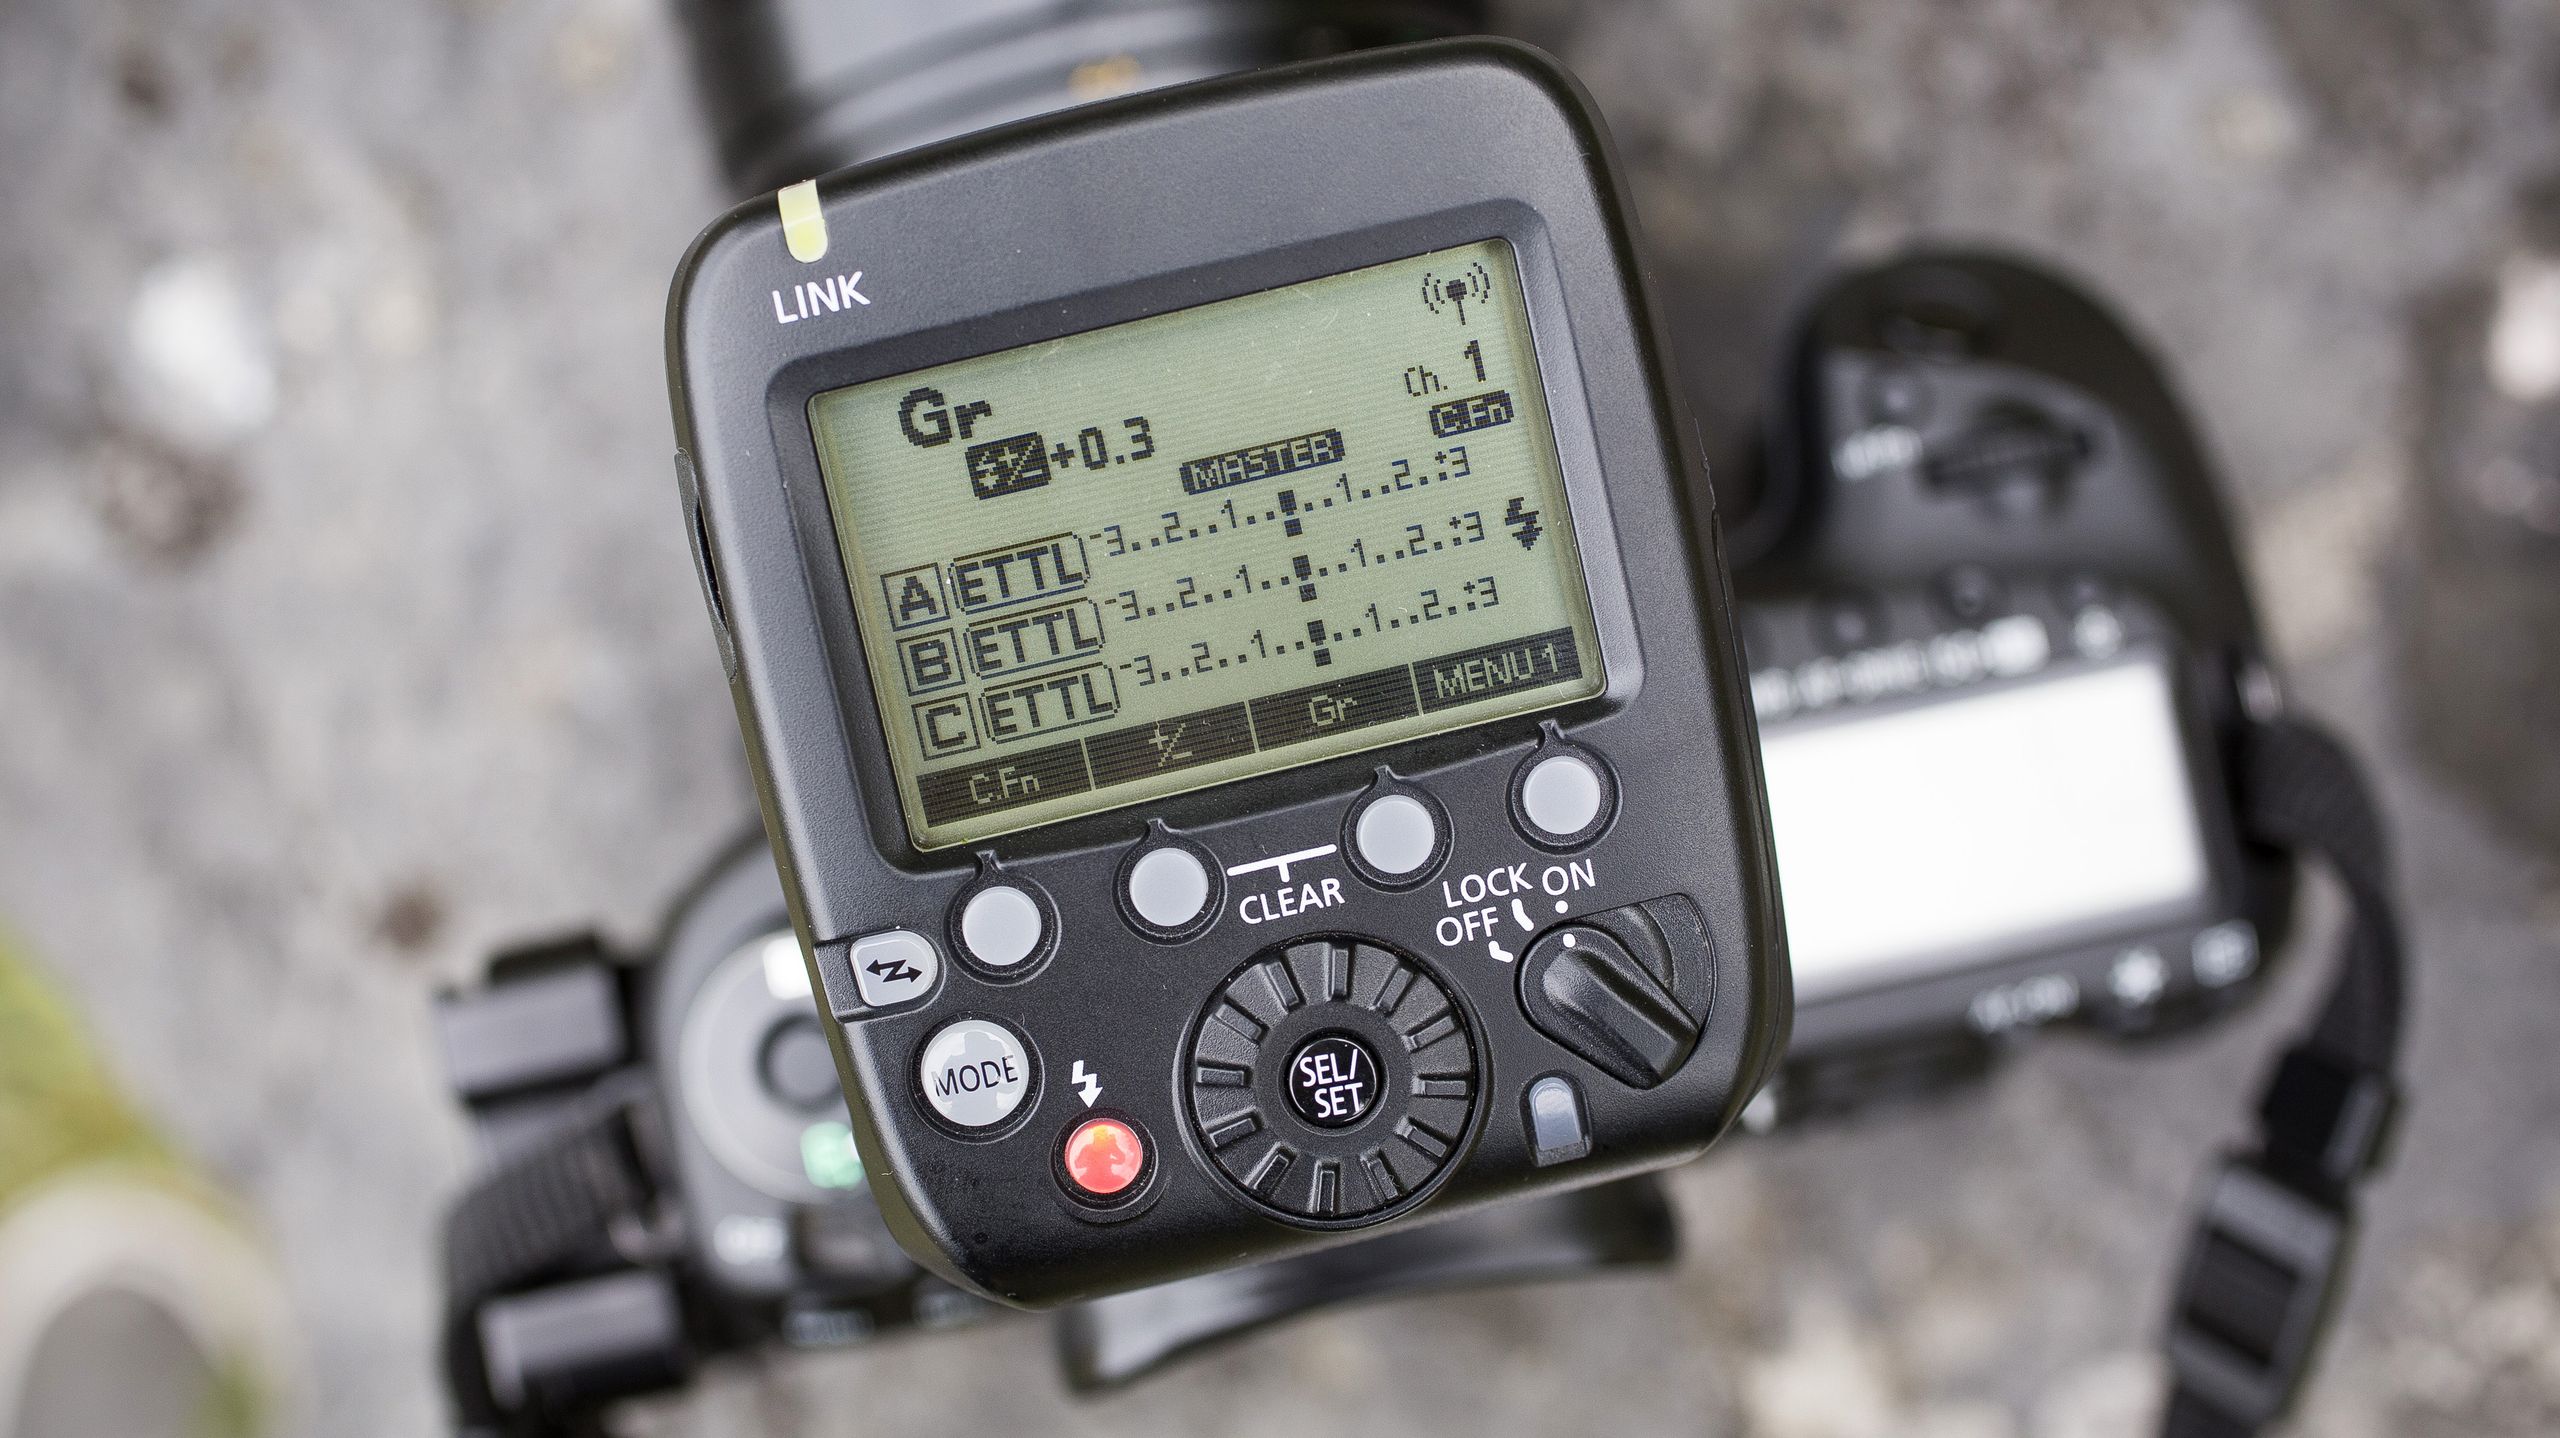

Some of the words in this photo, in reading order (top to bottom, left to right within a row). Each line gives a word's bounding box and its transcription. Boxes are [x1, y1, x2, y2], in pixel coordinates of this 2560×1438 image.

[771, 270, 871, 324] LINK
[1404, 364, 1448, 397] Ch.
[1463, 339, 1487, 382] 1
[897, 386, 993, 448] Gr
[1051, 415, 1156, 471] +0.3
[1191, 433, 1338, 490] MASTER
[900, 575, 938, 621] A
[954, 543, 1084, 607] ETTL
[908, 638, 953, 687] B
[969, 608, 1100, 672] ETTL
[1433, 646, 1535, 699] MENU
[1541, 642, 1559, 673] 1
[925, 702, 968, 751] C
[984, 673, 1115, 737] ETTL
[1307, 693, 1358, 728] Gr
[1239, 877, 1346, 925] CLEAR
[1442, 862, 1534, 909] LOCK
[1541, 858, 1597, 897] ON
[1435, 905, 1500, 947] OFF
[932, 1054, 1020, 1098] MODE
[1298, 1048, 1359, 1088] SEL/
[1313, 1081, 1364, 1119] SET
